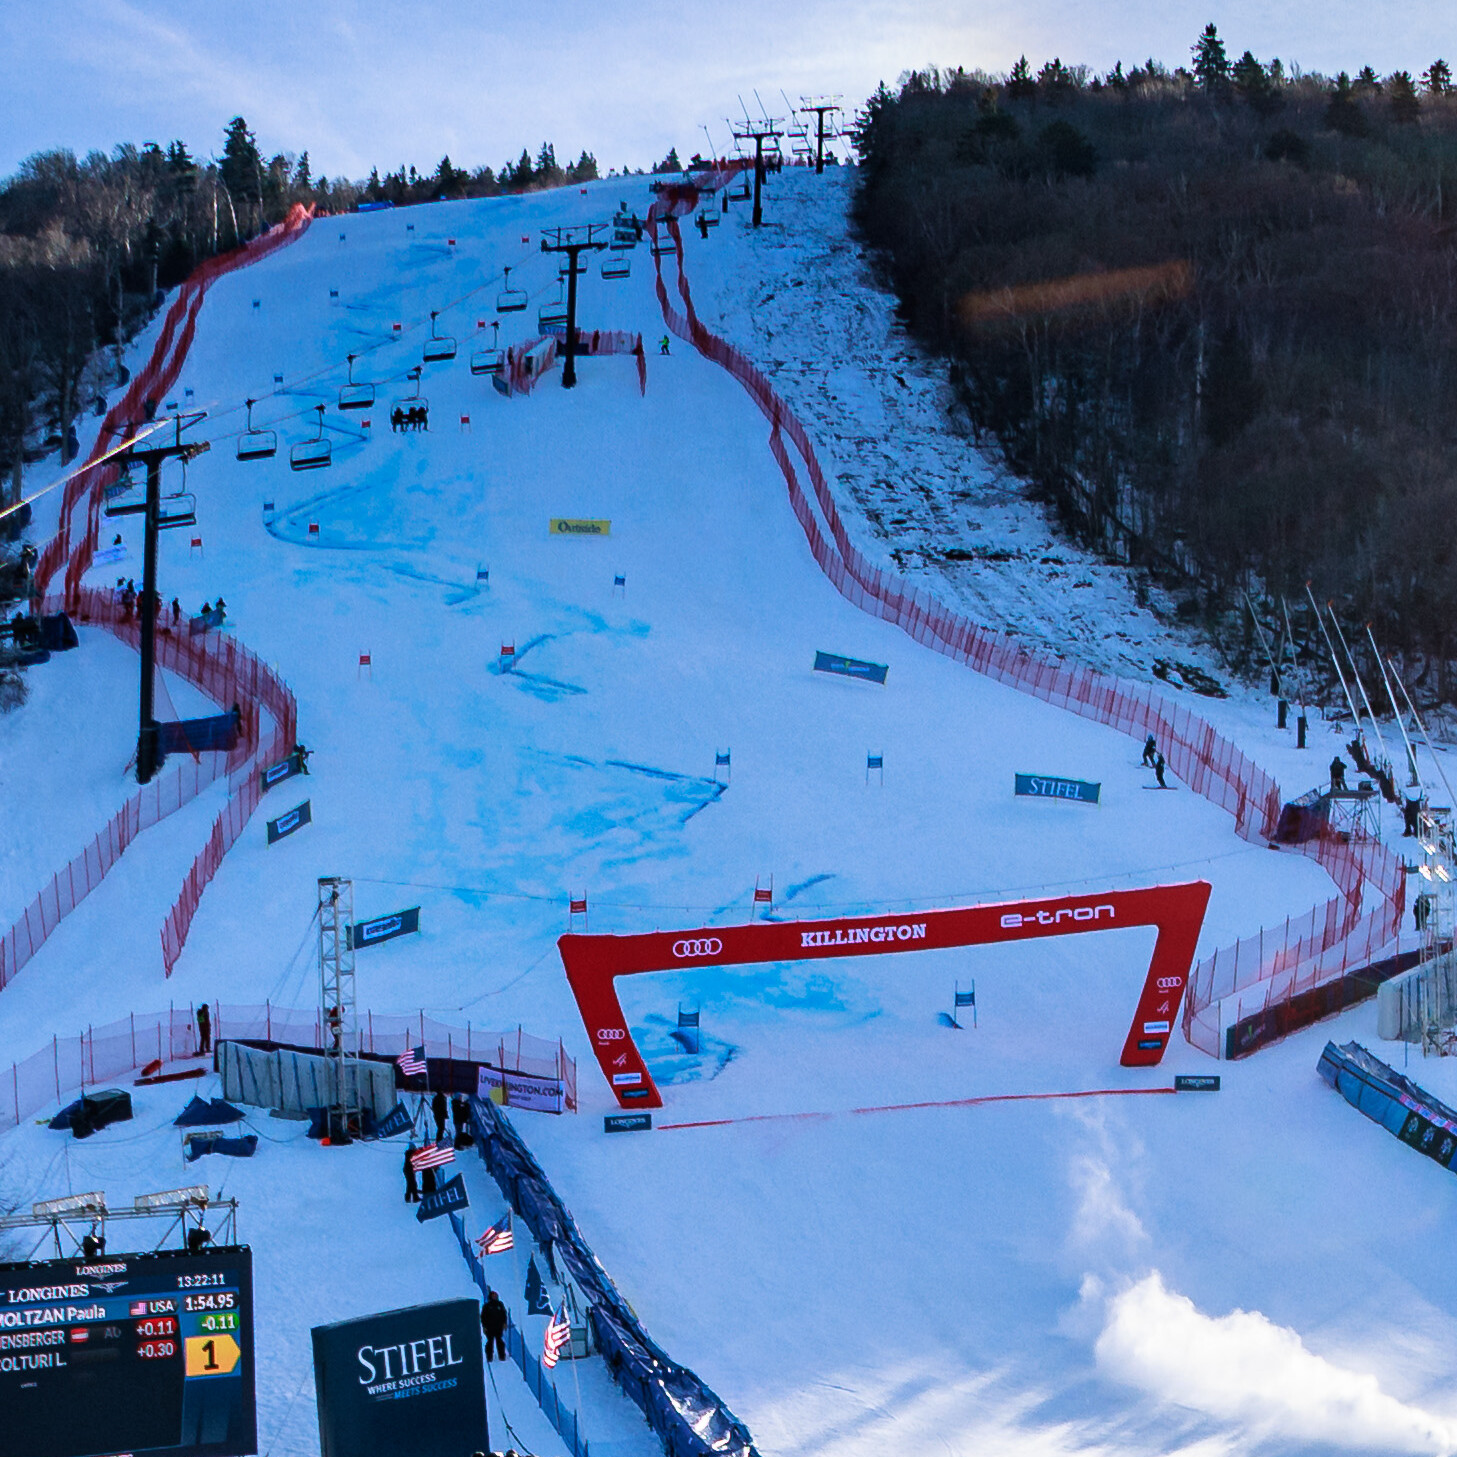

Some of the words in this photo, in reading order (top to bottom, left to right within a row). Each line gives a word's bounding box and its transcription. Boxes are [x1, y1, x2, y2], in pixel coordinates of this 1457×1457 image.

[558, 520, 601, 535] Outside
[1028, 776, 1082, 799] STIFEL
[1000, 904, 1115, 929] e-tron
[800, 923, 927, 948] KILLINGTON
[76, 1263, 127, 1276] LONGINES
[177, 1273, 225, 1288] 13:22:11
[8, 1284, 90, 1304] LONGINES
[150, 1302, 175, 1313] USA
[186, 1294, 234, 1312] 1:54.95
[67, 1304, 106, 1321] Paula
[136, 1320, 174, 1337] +0.11
[201, 1315, 236, 1331] -0.11
[137, 1343, 174, 1358] +0.30
[202, 1340, 219, 1371] 1
[358, 1334, 463, 1386] STIFEL
[367, 1380, 398, 1395] WHERE
[399, 1373, 437, 1390] SUCCESS
[422, 1378, 457, 1394] SUCCESS
